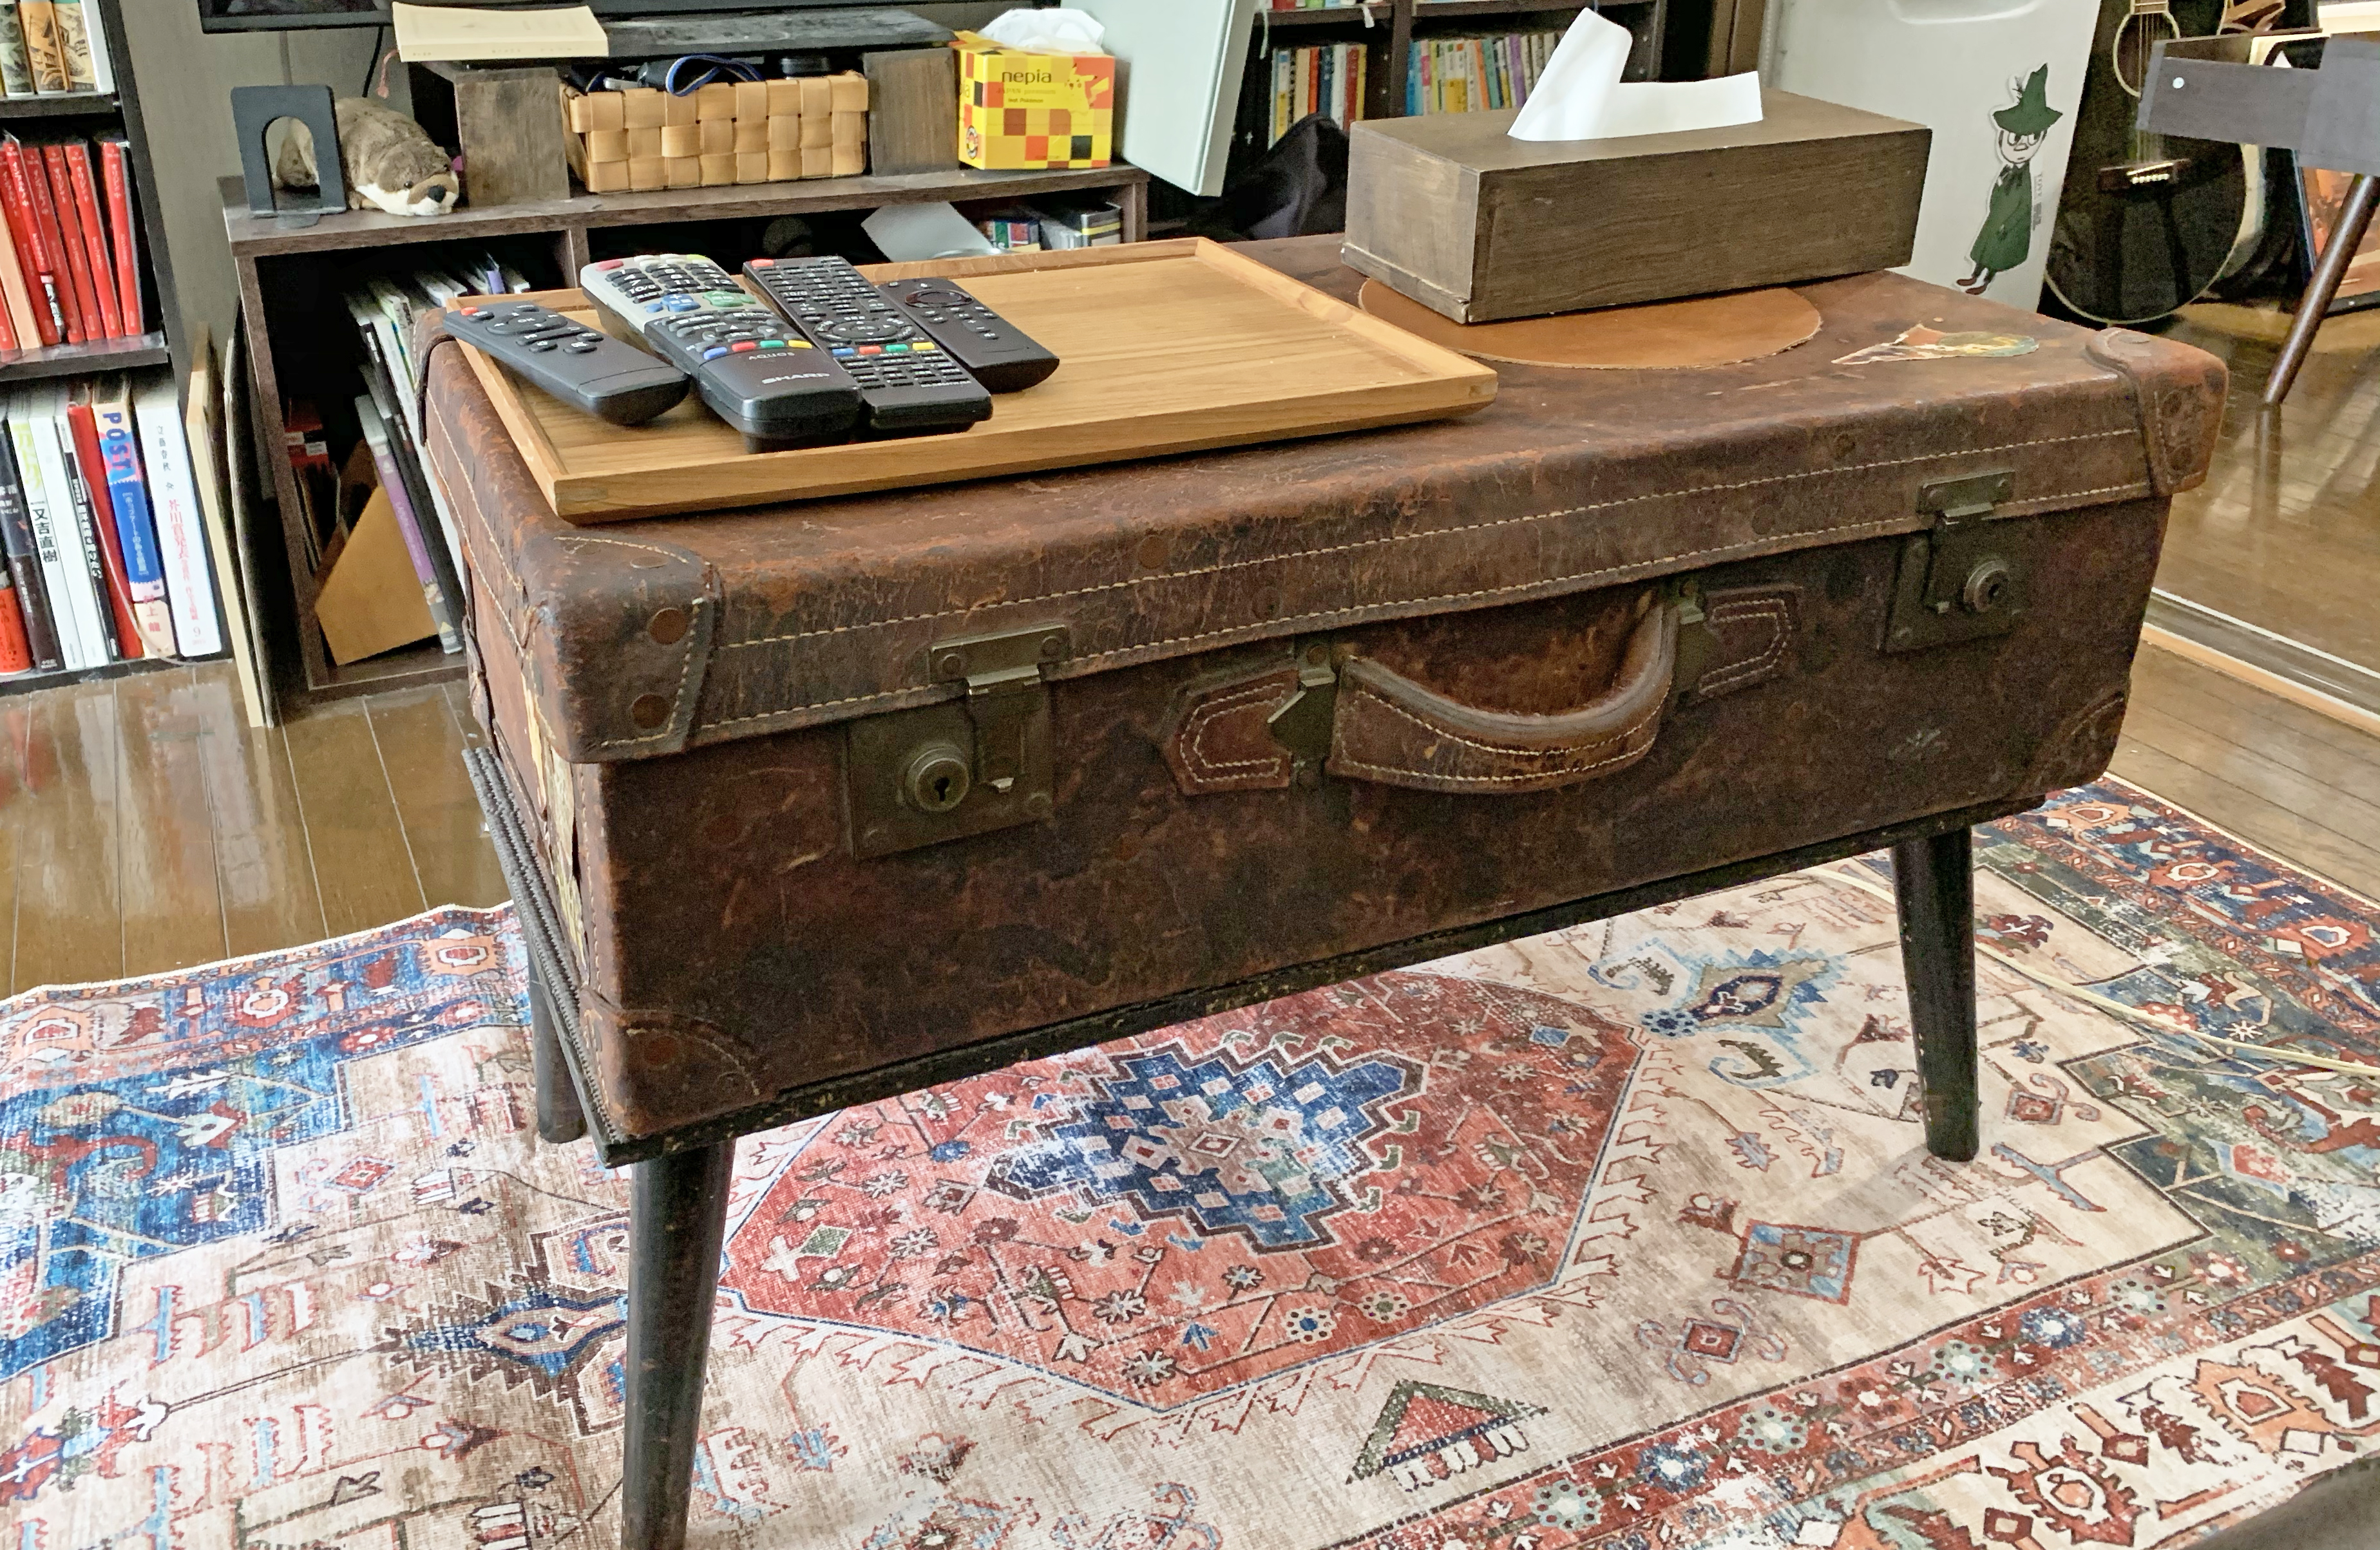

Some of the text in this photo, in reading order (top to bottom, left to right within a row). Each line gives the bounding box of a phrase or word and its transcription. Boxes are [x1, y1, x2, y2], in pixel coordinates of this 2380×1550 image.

[1002, 69, 1052, 85] nepia
[629, 285, 656, 294] 10/0
[761, 373, 830, 384] SHARP
[102, 412, 131, 469] POST
[33, 508, 59, 563] 又吉直樹
[193, 626, 202, 638] 9
